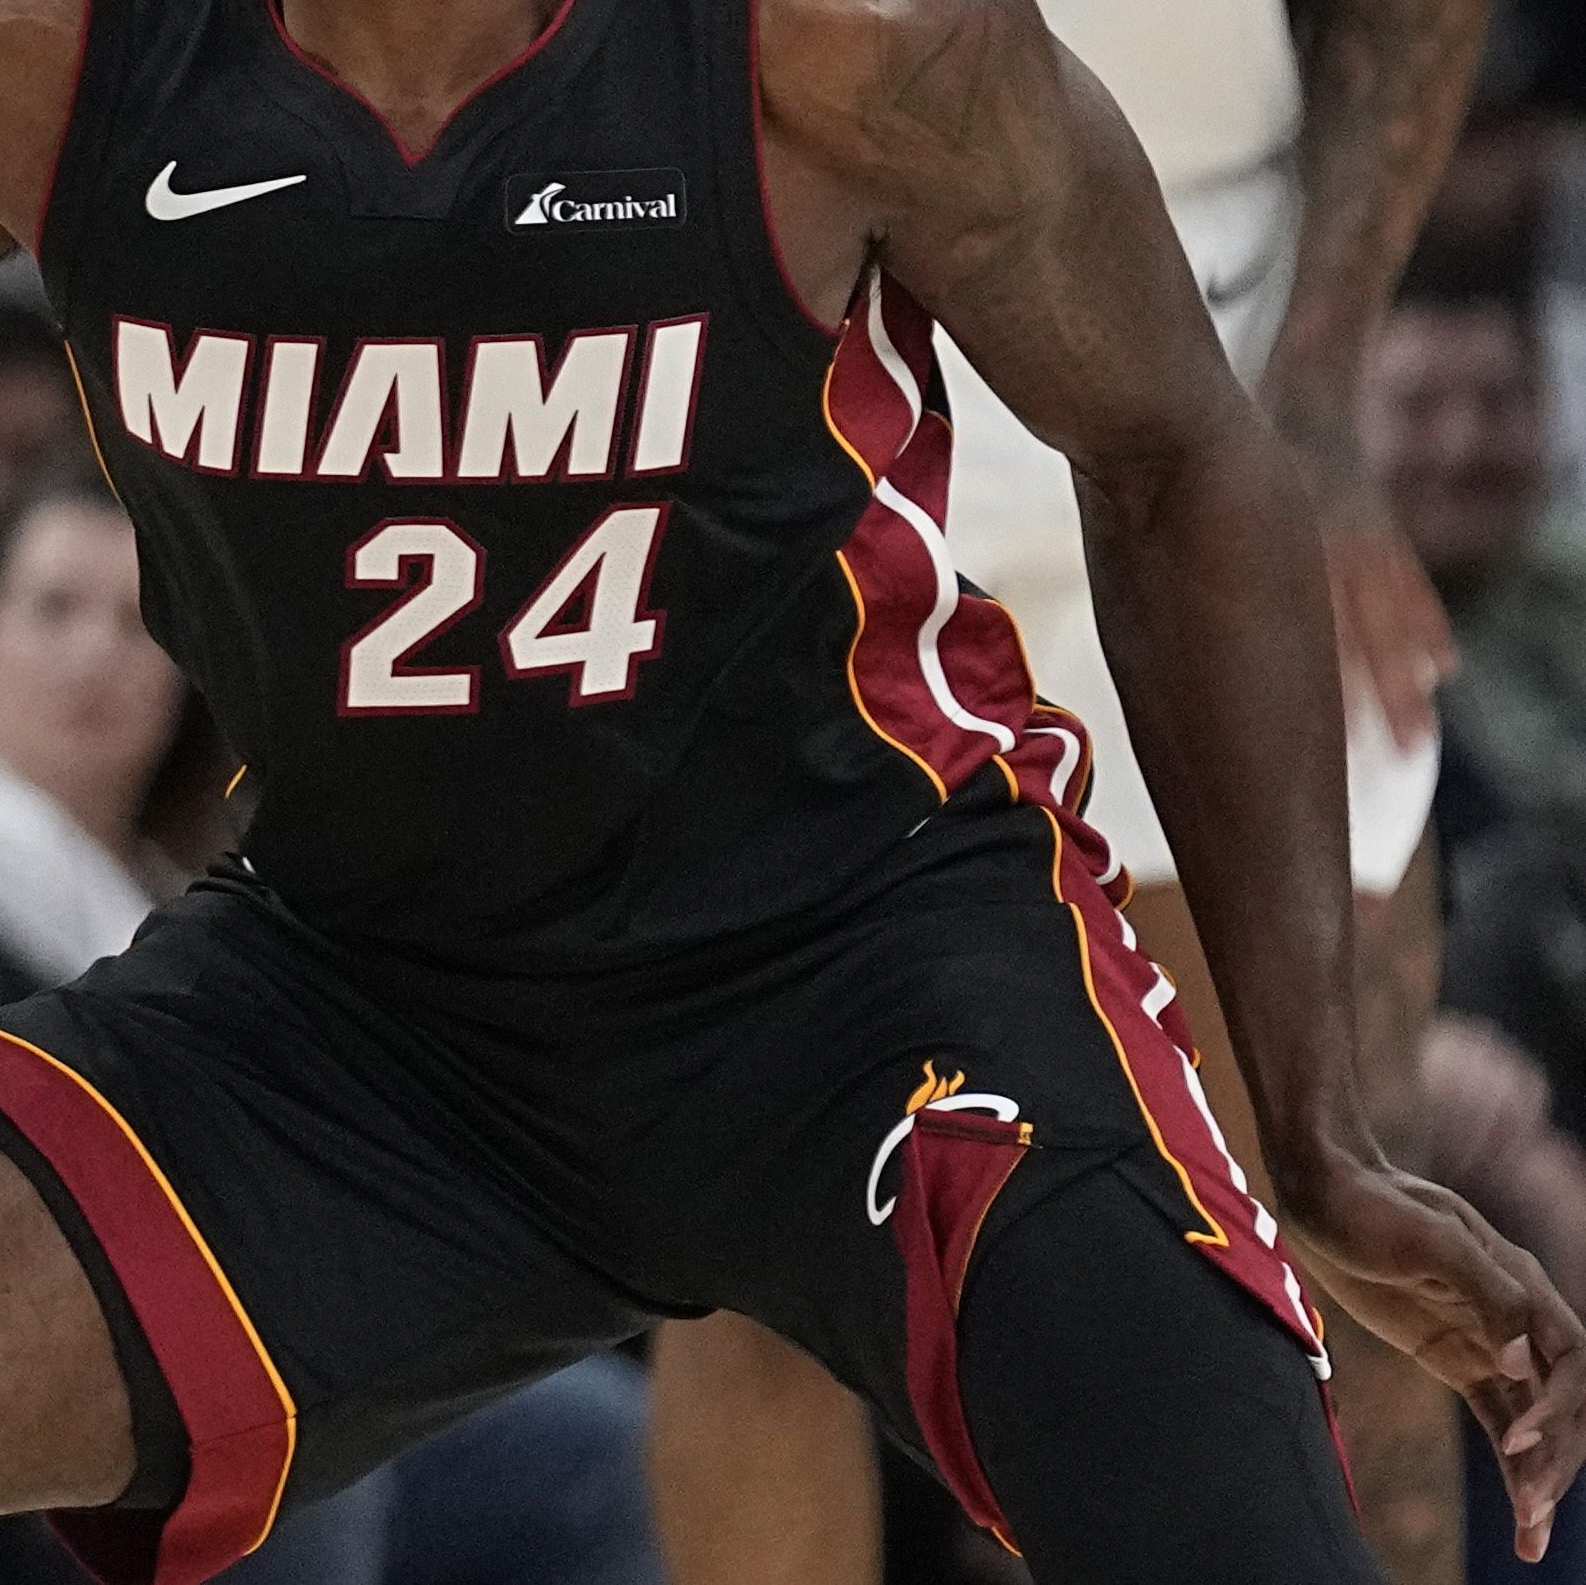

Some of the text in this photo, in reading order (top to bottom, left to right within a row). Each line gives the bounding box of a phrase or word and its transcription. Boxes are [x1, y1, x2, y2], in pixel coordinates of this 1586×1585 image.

[552, 193, 677, 222] Carnival
[112, 312, 710, 484] MIAMI
[337, 499, 669, 716] 24
